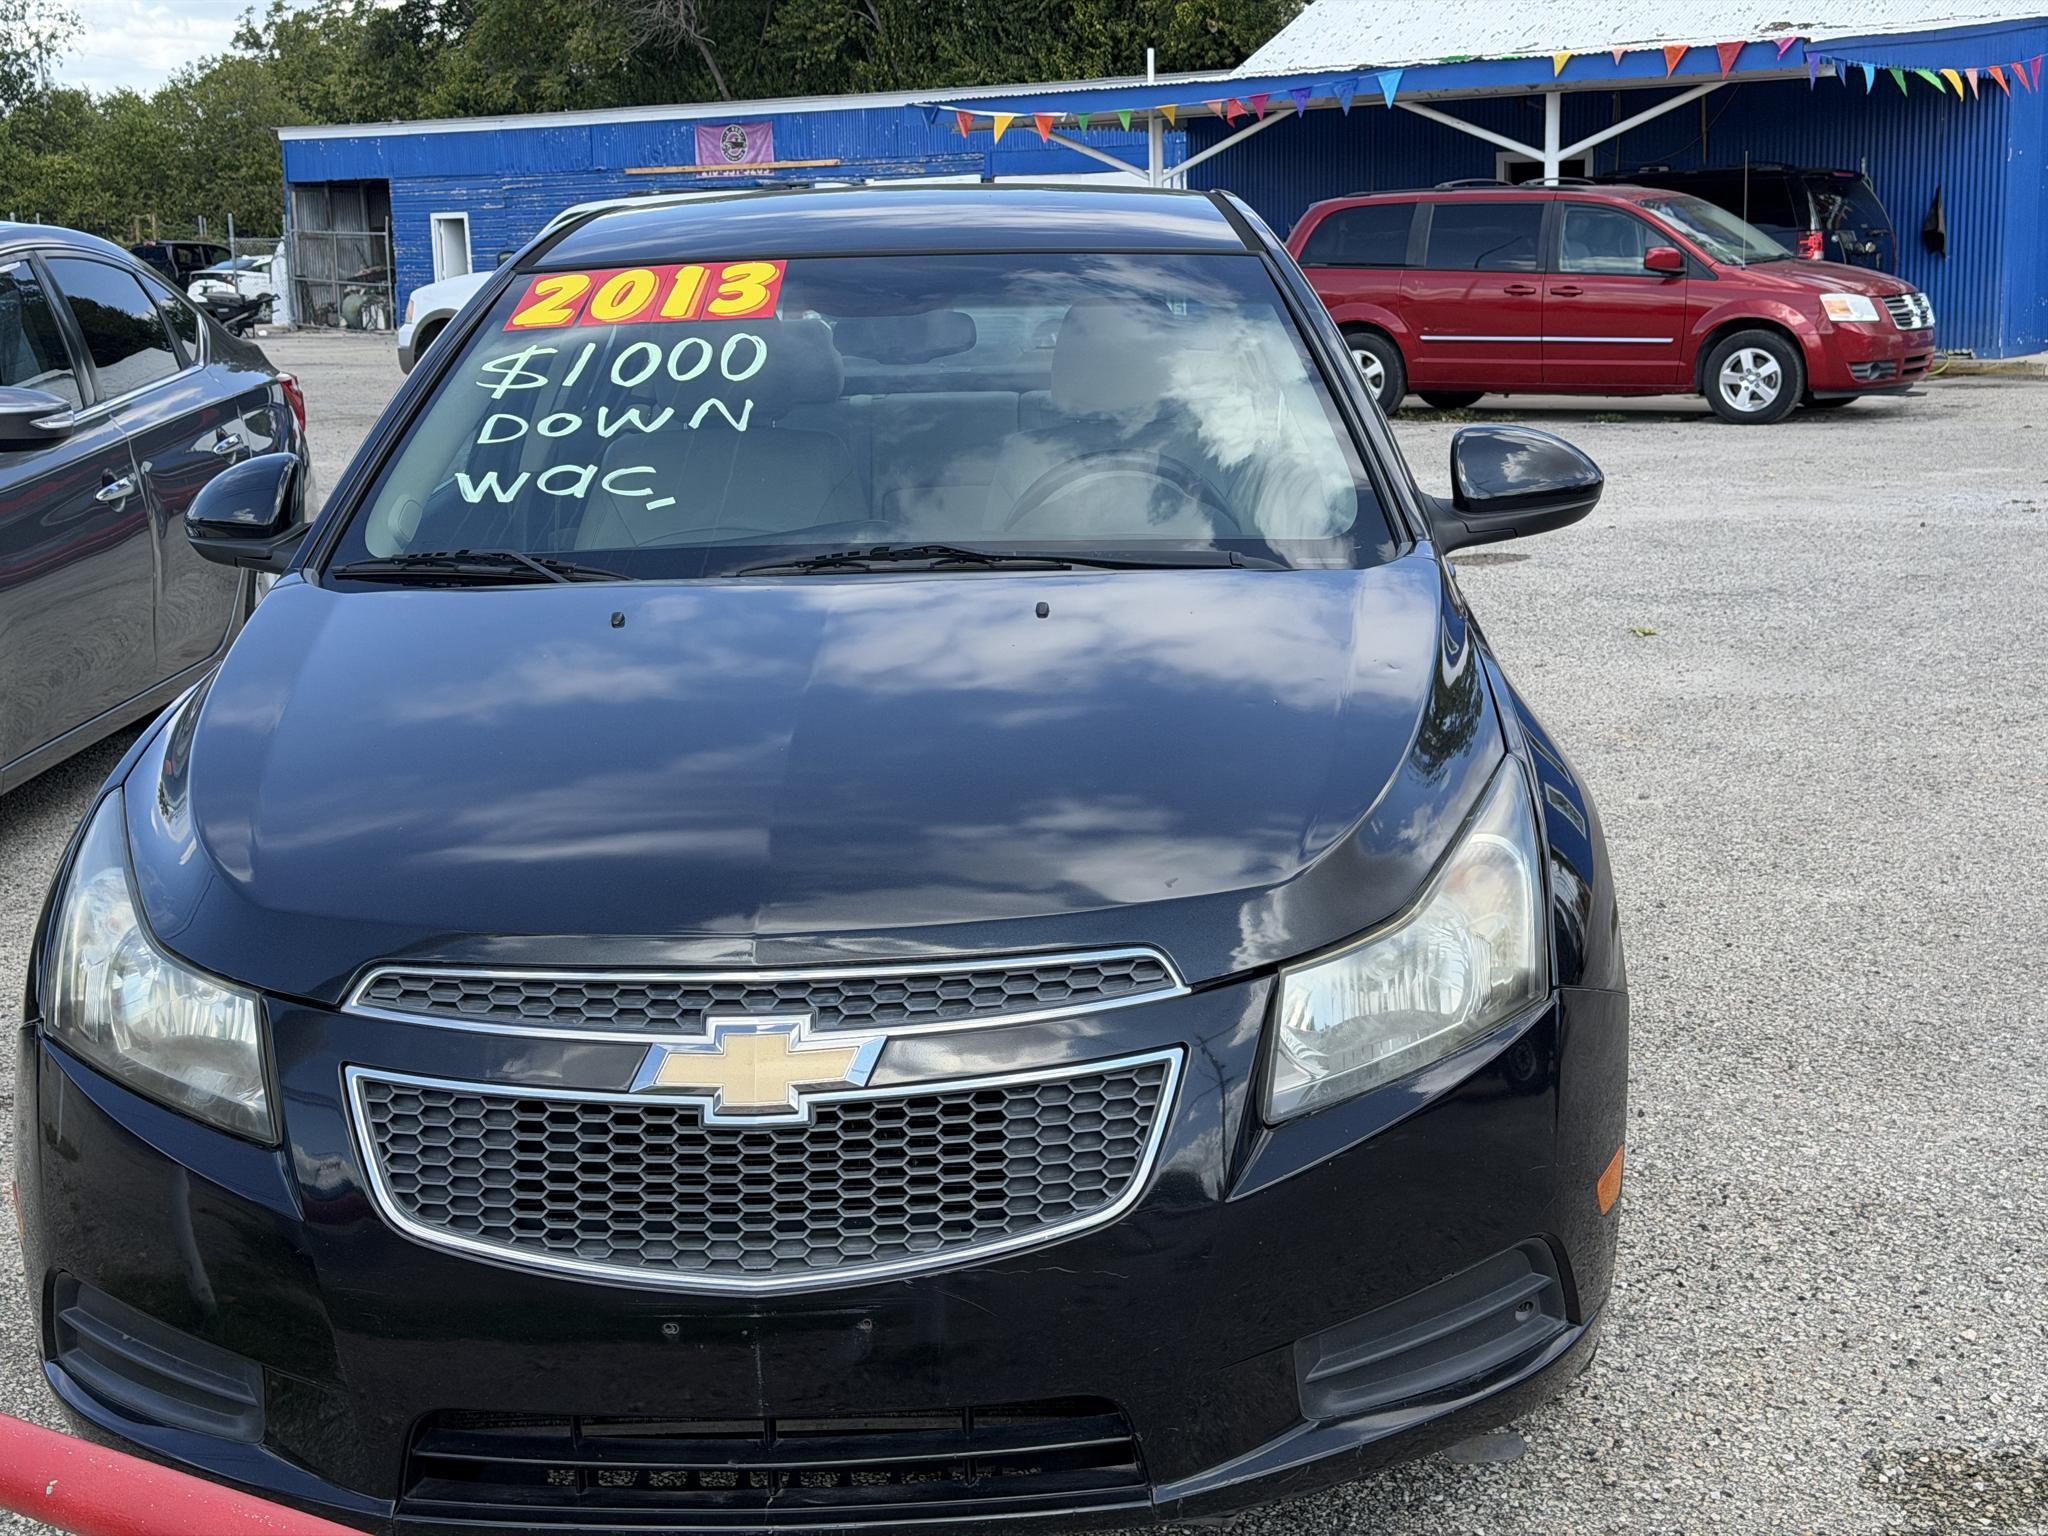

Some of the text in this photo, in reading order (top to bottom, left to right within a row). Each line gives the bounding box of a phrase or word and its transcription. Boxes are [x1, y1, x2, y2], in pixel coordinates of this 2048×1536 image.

[512, 262, 780, 327] 2013
[475, 333, 768, 399] $1000
[477, 398, 754, 444] DOWN
